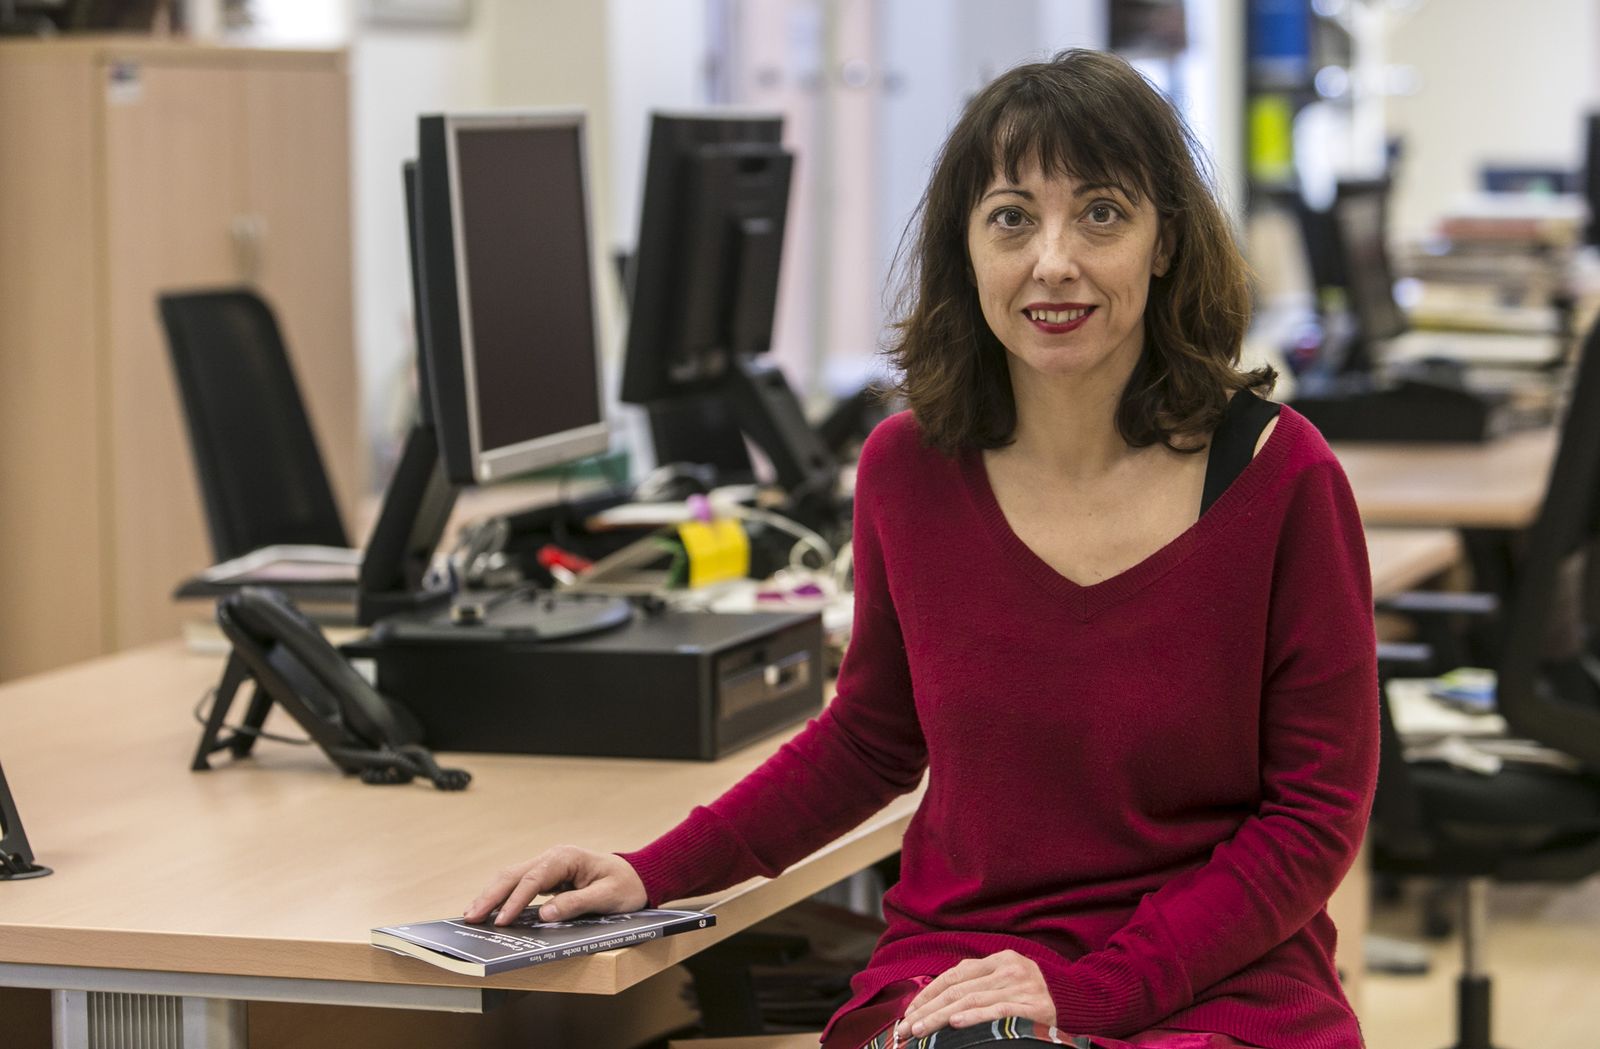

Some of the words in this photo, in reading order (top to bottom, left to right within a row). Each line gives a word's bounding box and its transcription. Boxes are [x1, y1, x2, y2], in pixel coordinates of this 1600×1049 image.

[624, 933, 637, 942] que
[638, 930, 656, 939] Cosas
[598, 937, 623, 948] acechan
[562, 947, 581, 957] noche
[582, 945, 589, 953] la
